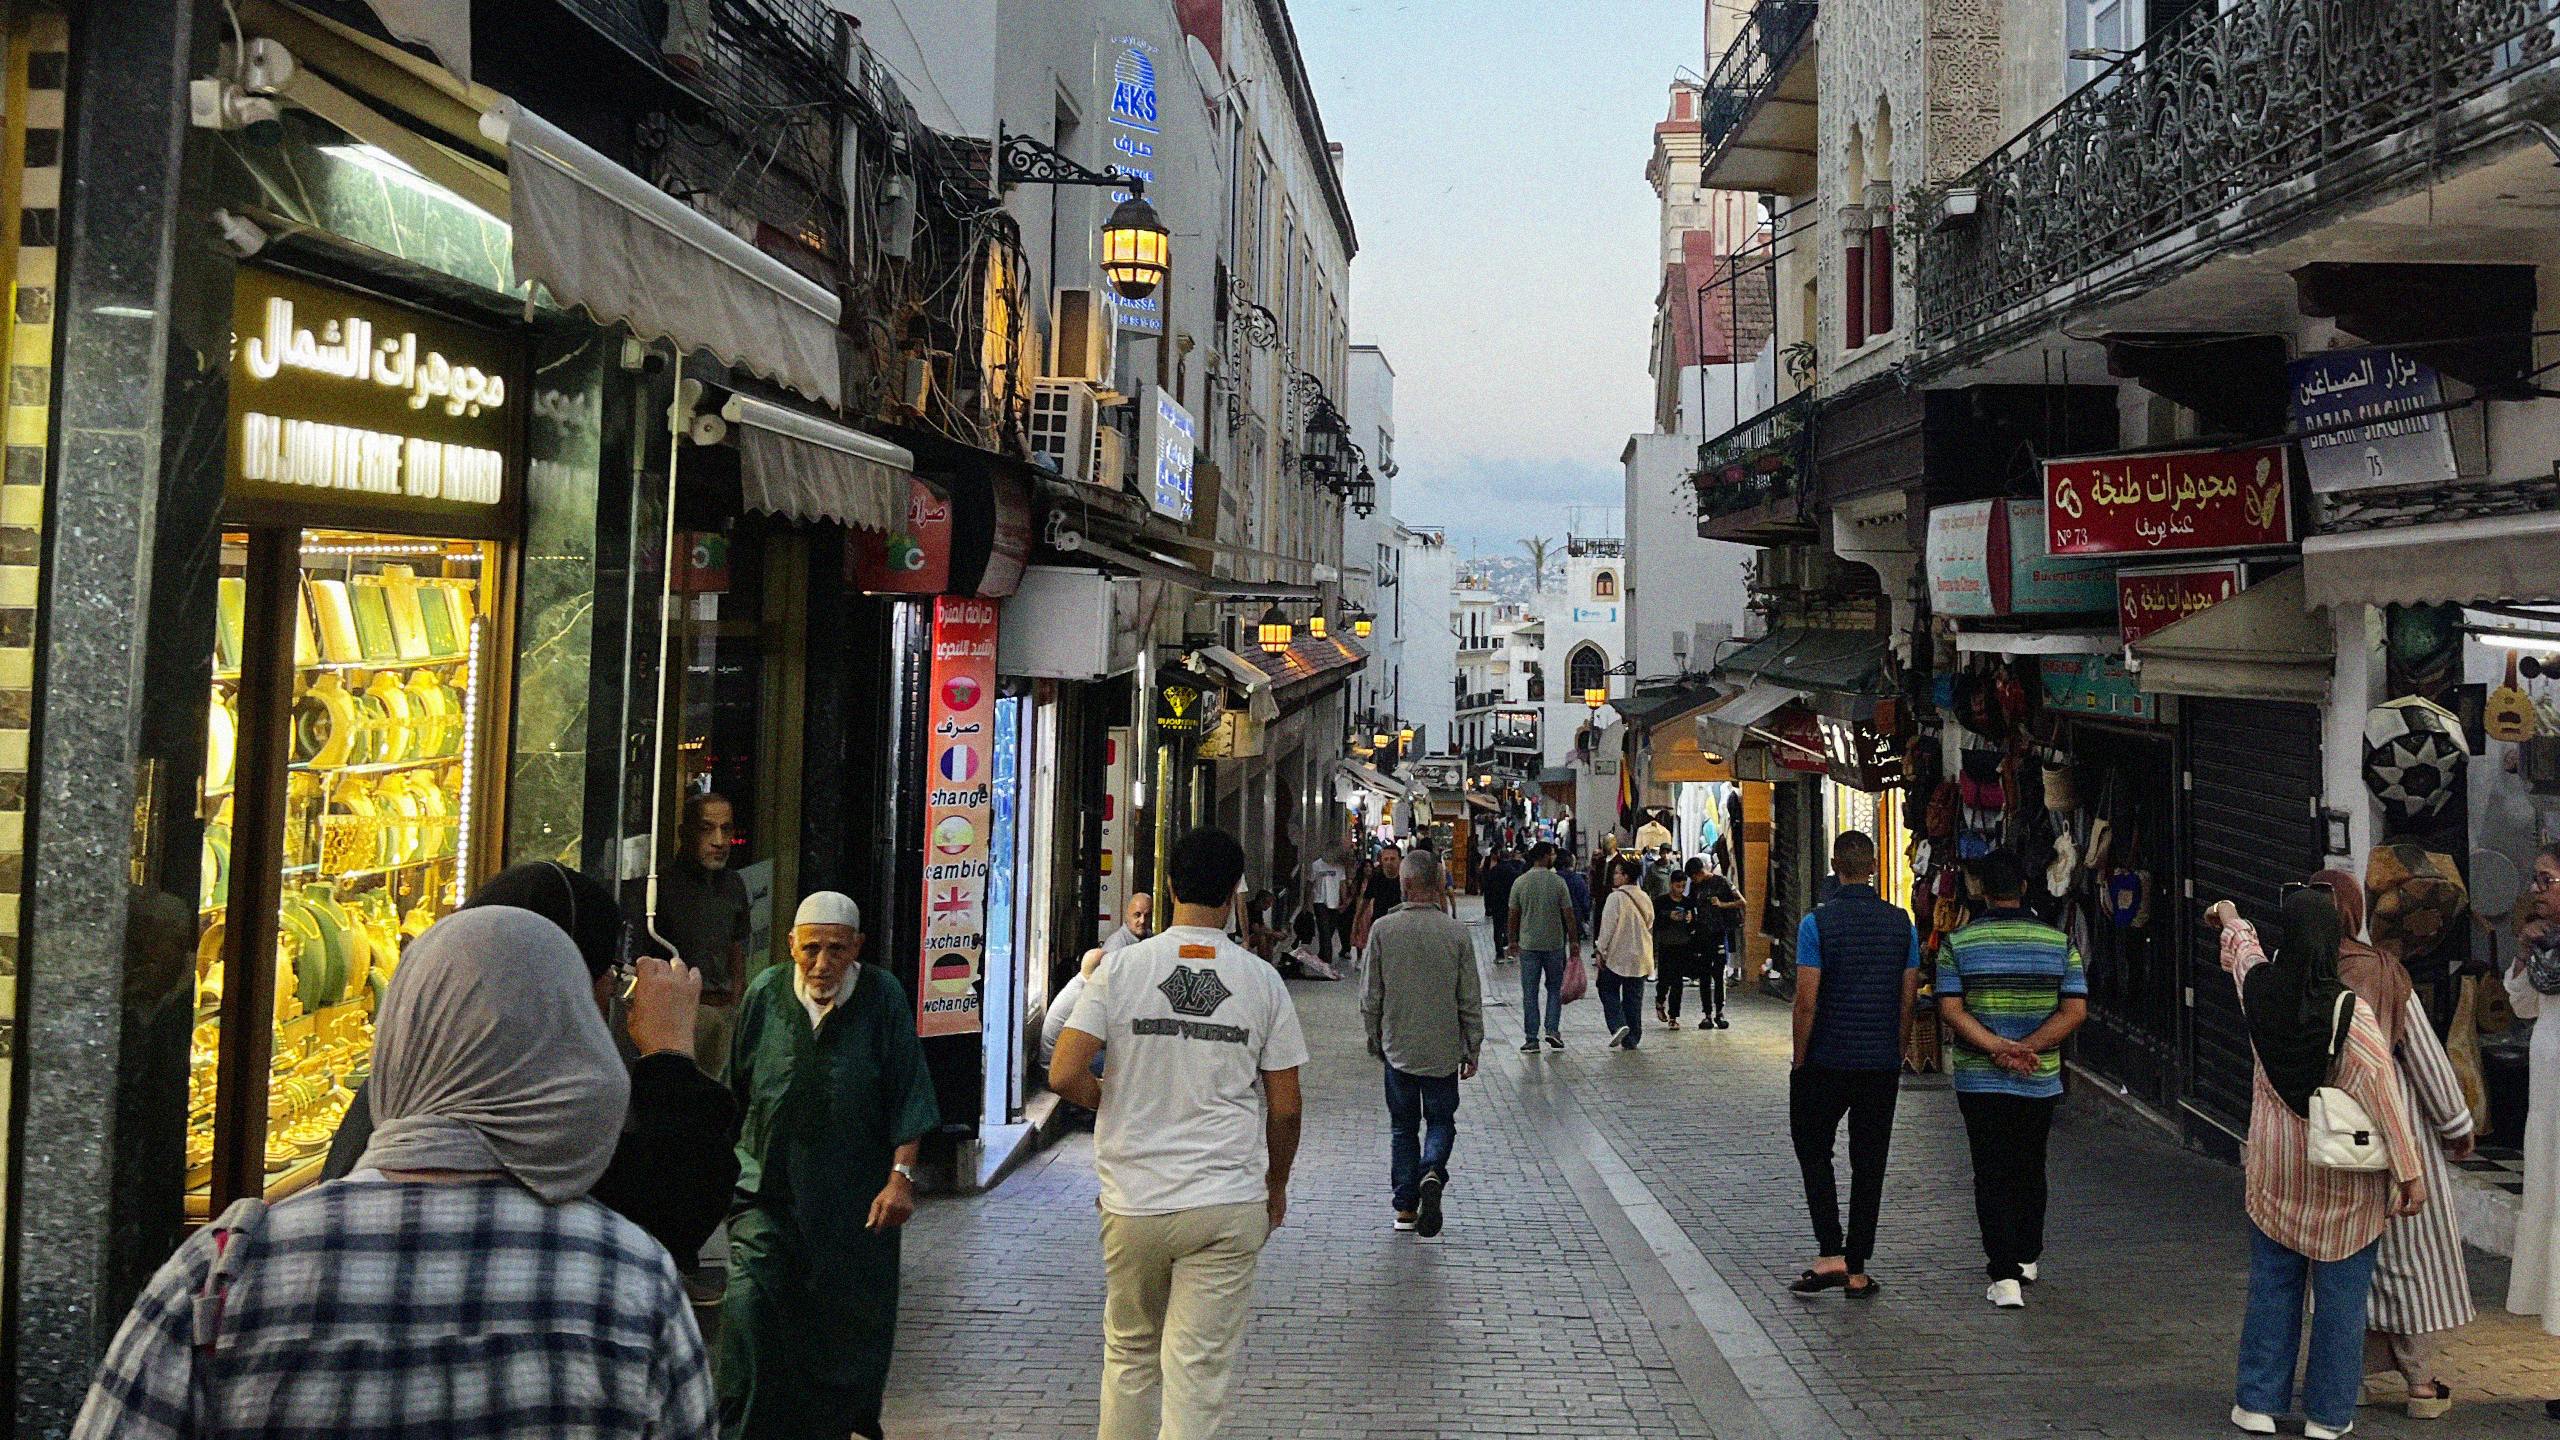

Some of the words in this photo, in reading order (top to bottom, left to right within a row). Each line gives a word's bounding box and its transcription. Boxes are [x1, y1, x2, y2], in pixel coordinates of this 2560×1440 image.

[1111, 80, 1157, 122] AKS
[1113, 133, 1153, 157] صرف
[245, 296, 372, 380] الشمال
[371, 333, 505, 418] مجوهرات
[2300, 357, 2375, 406] الصياغين
[2385, 351, 2418, 390] بزار
[2305, 408, 2357, 449] BAZAR
[2359, 394, 2430, 440] SIAGHIN
[243, 411, 404, 494] BIJOUTERIE
[405, 437, 441, 499] DU
[441, 443, 503, 504] NORD
[2366, 455, 2383, 477] 75
[2091, 465, 2141, 517] طنجة
[2146, 462, 2237, 512] مجوهرات
[2074, 528, 2088, 546] 73
[2170, 512, 2194, 535] عند
[936, 716, 981, 739] صرف
[931, 786, 989, 808] change
[925, 860, 988, 880] cambio
[1132, 1018, 1180, 1036] LOUIS
